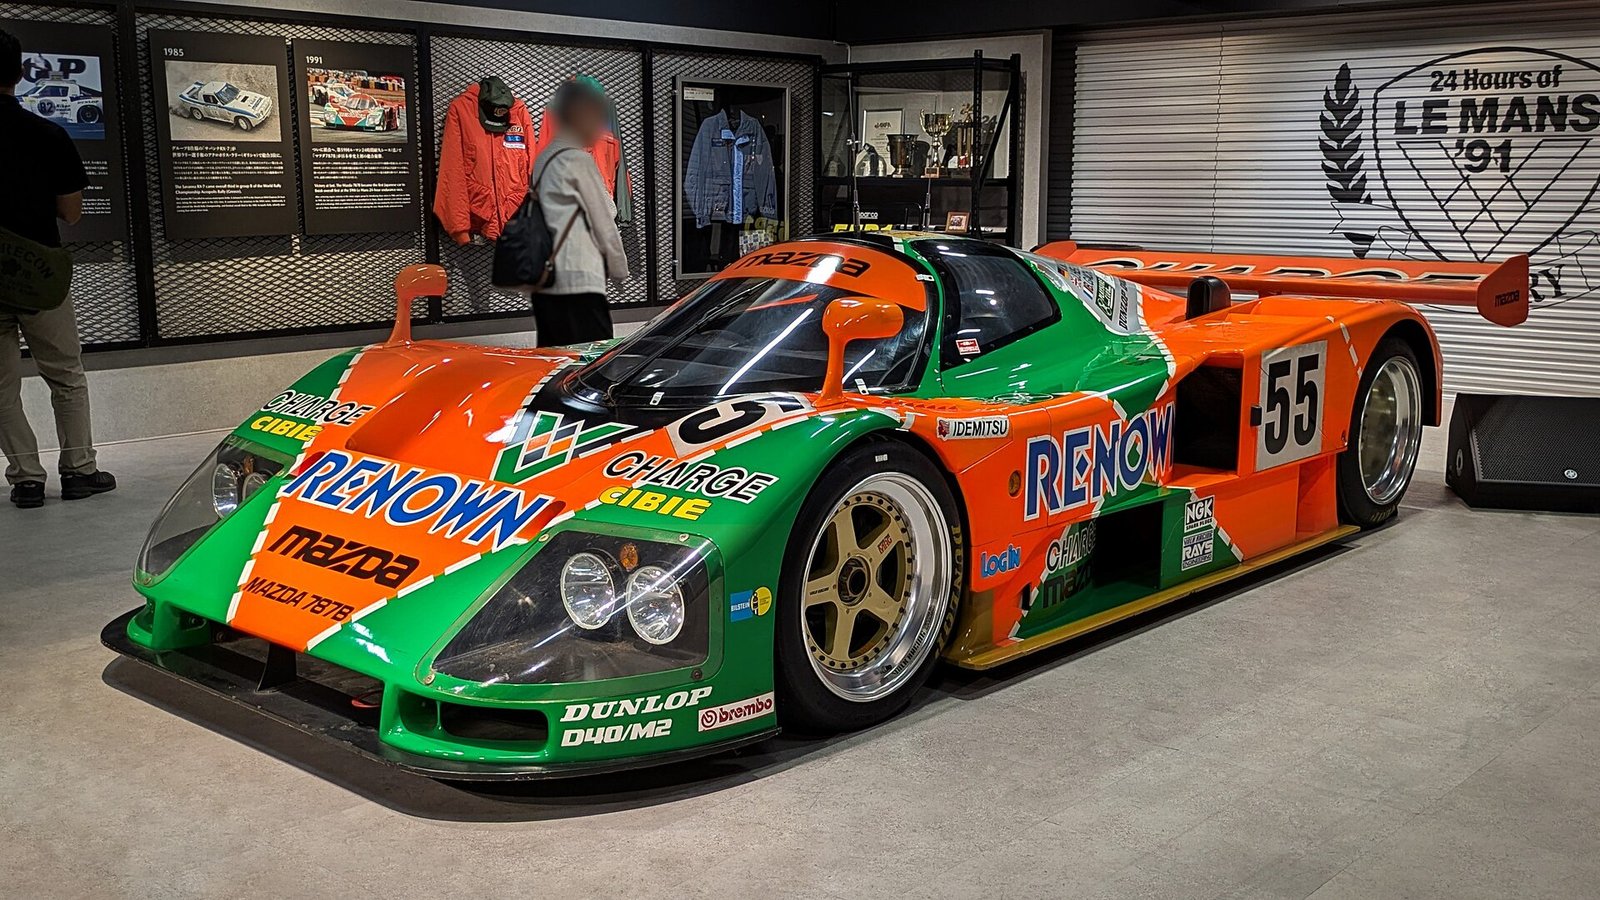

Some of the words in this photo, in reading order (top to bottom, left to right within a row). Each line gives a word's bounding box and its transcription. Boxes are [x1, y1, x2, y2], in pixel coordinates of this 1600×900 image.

[163, 47, 185, 57] 1985
[306, 56, 322, 64] 1991
[1430, 69, 1457, 92] 24
[1463, 67, 1532, 91] Hours
[1537, 64, 1562, 88] of
[1394, 99, 1449, 135] LE
[1458, 93, 1600, 134] MANS
[1455, 138, 1513, 173] '91
[735, 251, 871, 279] mazda
[1495, 290, 1520, 308] mazda
[262, 389, 376, 428] CHARGE
[1264, 353, 1320, 455] 55
[952, 419, 1009, 438] IDEMITSU
[1024, 401, 1176, 522] RENOW
[602, 450, 779, 504] CHARGE
[278, 450, 554, 552] RENOWN
[1186, 498, 1213, 524] NGK
[267, 525, 420, 589] mazda
[1183, 541, 1213, 560] RAYS
[247, 576, 303, 609] MAZDA
[302, 594, 355, 623] 787B
[730, 601, 751, 612] BILSTEIN
[560, 686, 713, 722] DUNLOP
[718, 697, 773, 723] brembo
[561, 719, 672, 747] D40/M2
